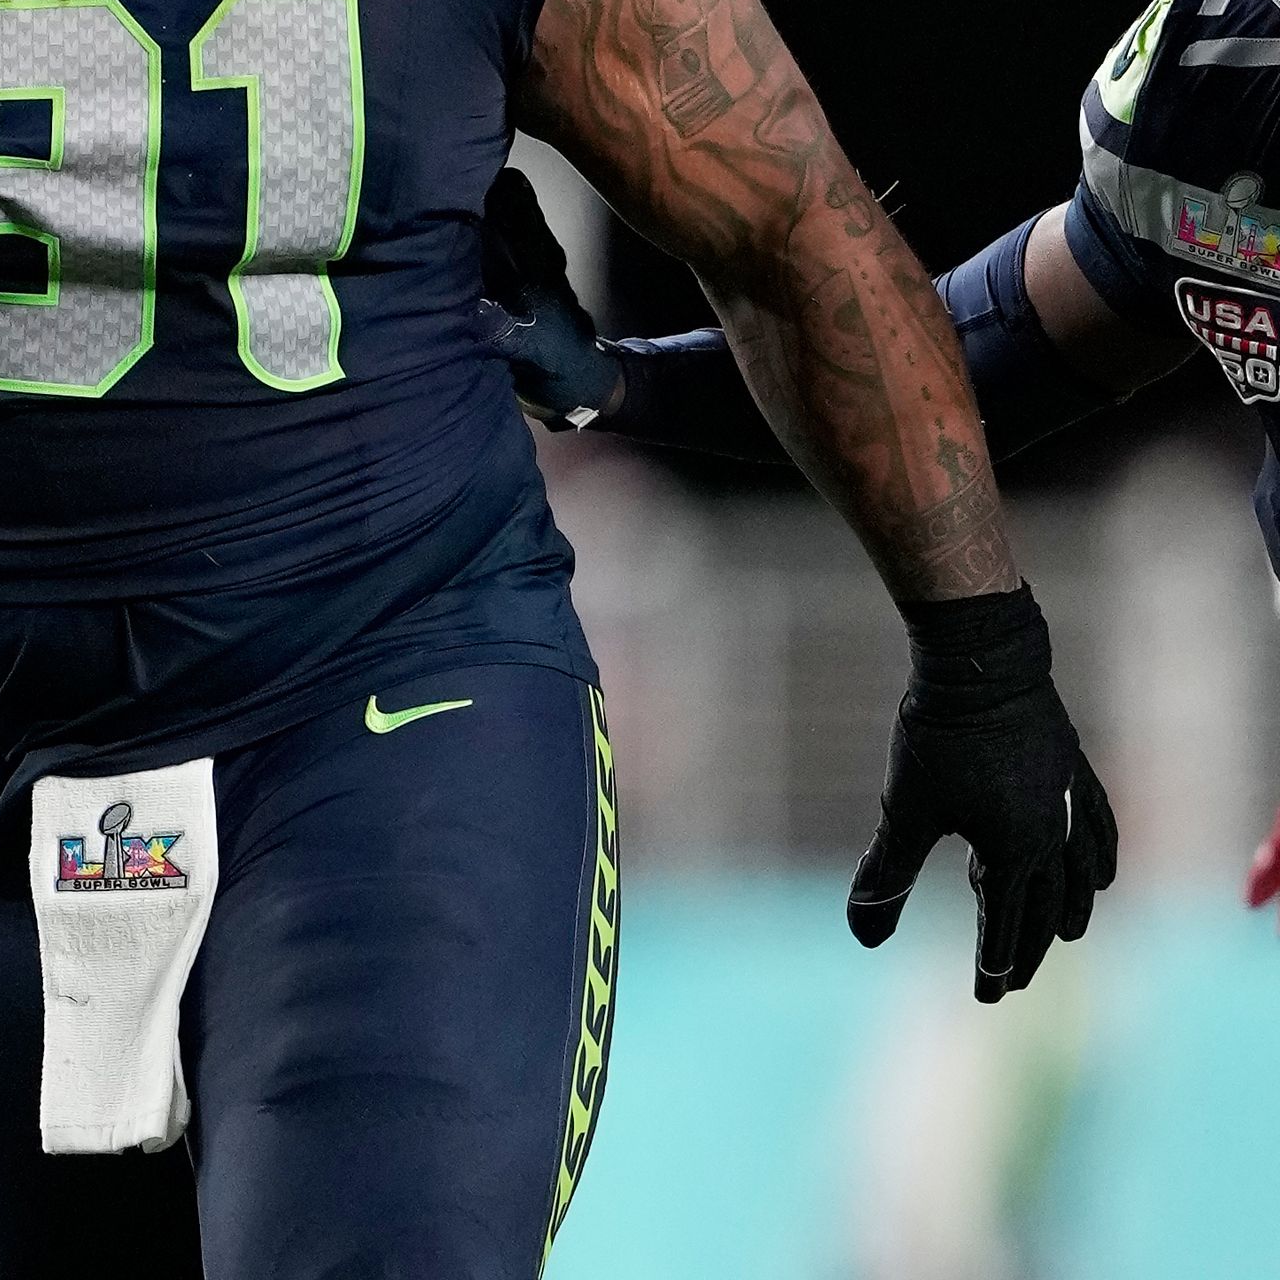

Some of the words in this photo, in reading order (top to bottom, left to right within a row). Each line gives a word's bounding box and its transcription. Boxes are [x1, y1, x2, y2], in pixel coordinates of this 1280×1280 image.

[1187, 244, 1234, 267] SUPER
[1239, 261, 1280, 280] BOWL
[1185, 291, 1278, 338] USA
[73, 880, 122, 890] SUPER
[128, 879, 171, 889] BOWL
